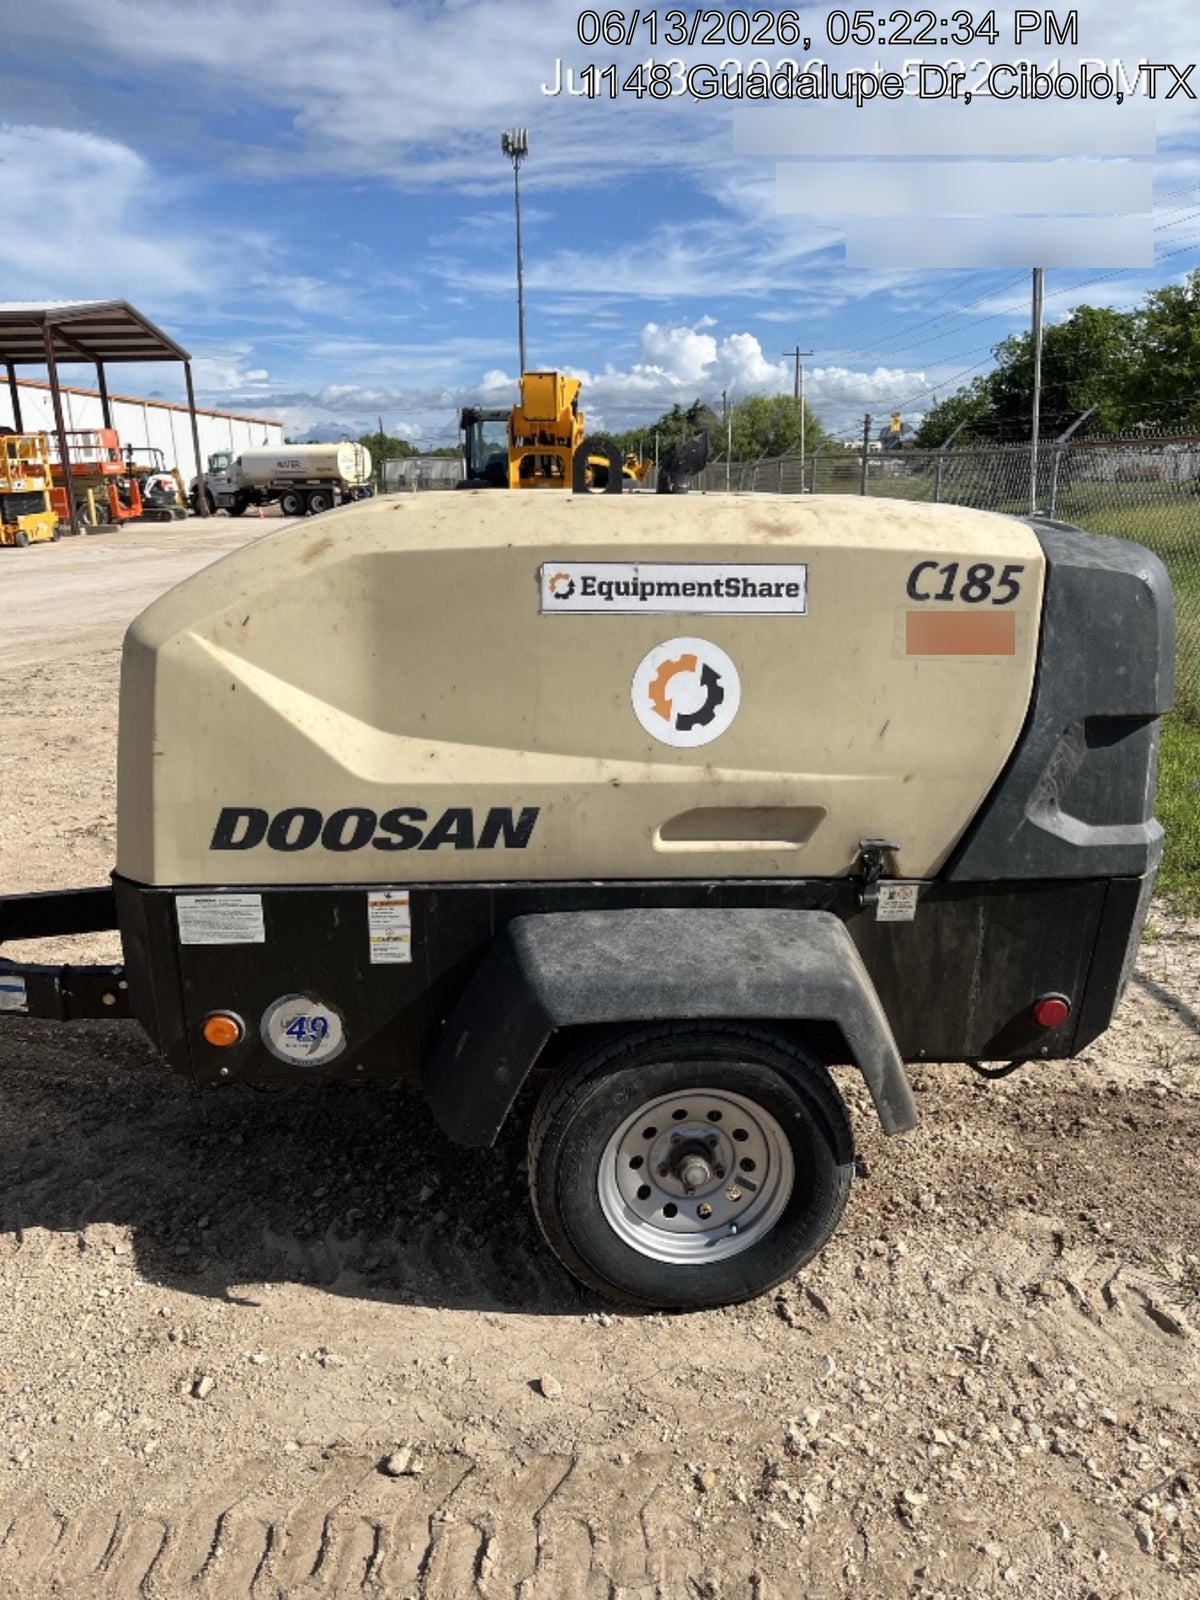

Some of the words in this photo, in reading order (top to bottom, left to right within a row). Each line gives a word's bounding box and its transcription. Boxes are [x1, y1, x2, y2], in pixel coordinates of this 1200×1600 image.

[580, 576, 800, 601] EquipmentShare
[906, 561, 1025, 605] C185
[209, 807, 541, 851] DOOSAN
[285, 1015, 328, 1041] 49
